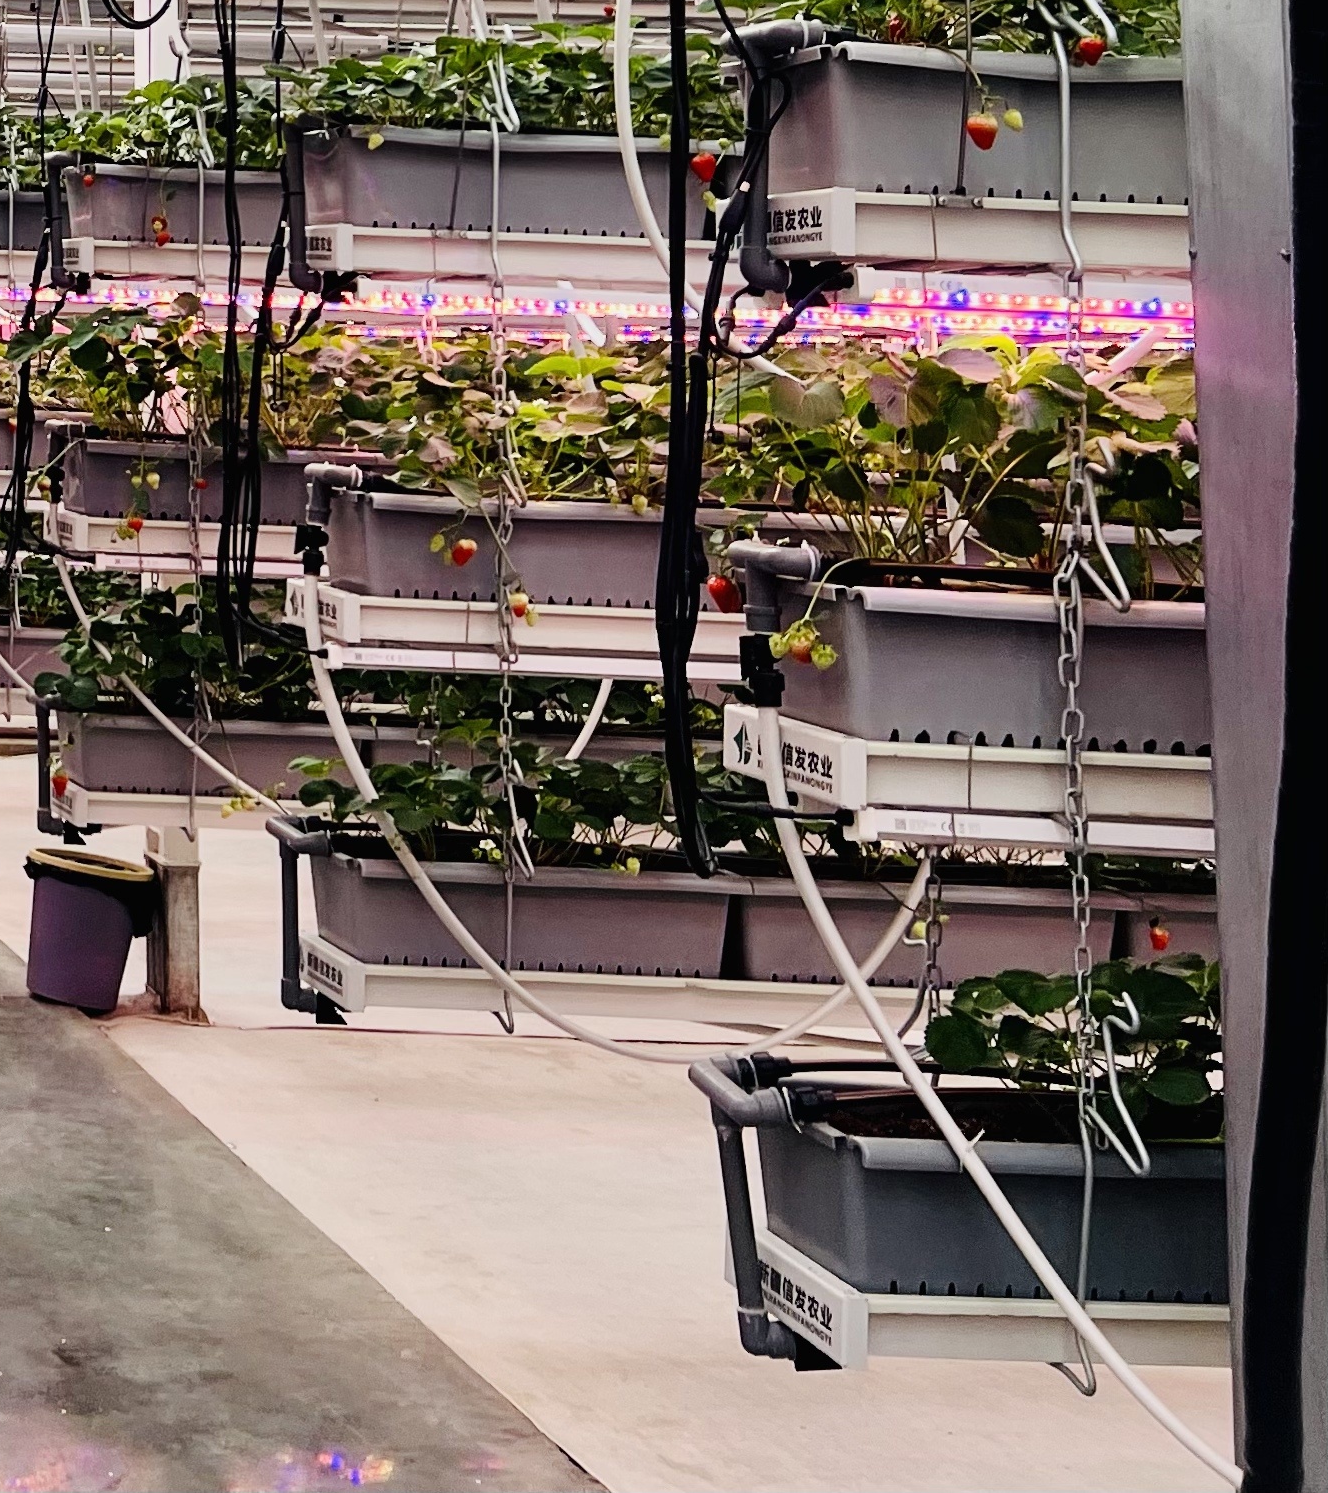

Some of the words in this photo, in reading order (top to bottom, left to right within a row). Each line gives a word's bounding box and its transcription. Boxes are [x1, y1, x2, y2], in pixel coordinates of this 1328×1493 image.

[767, 205, 823, 234] 信发农业
[757, 735, 833, 779] 信发农业
